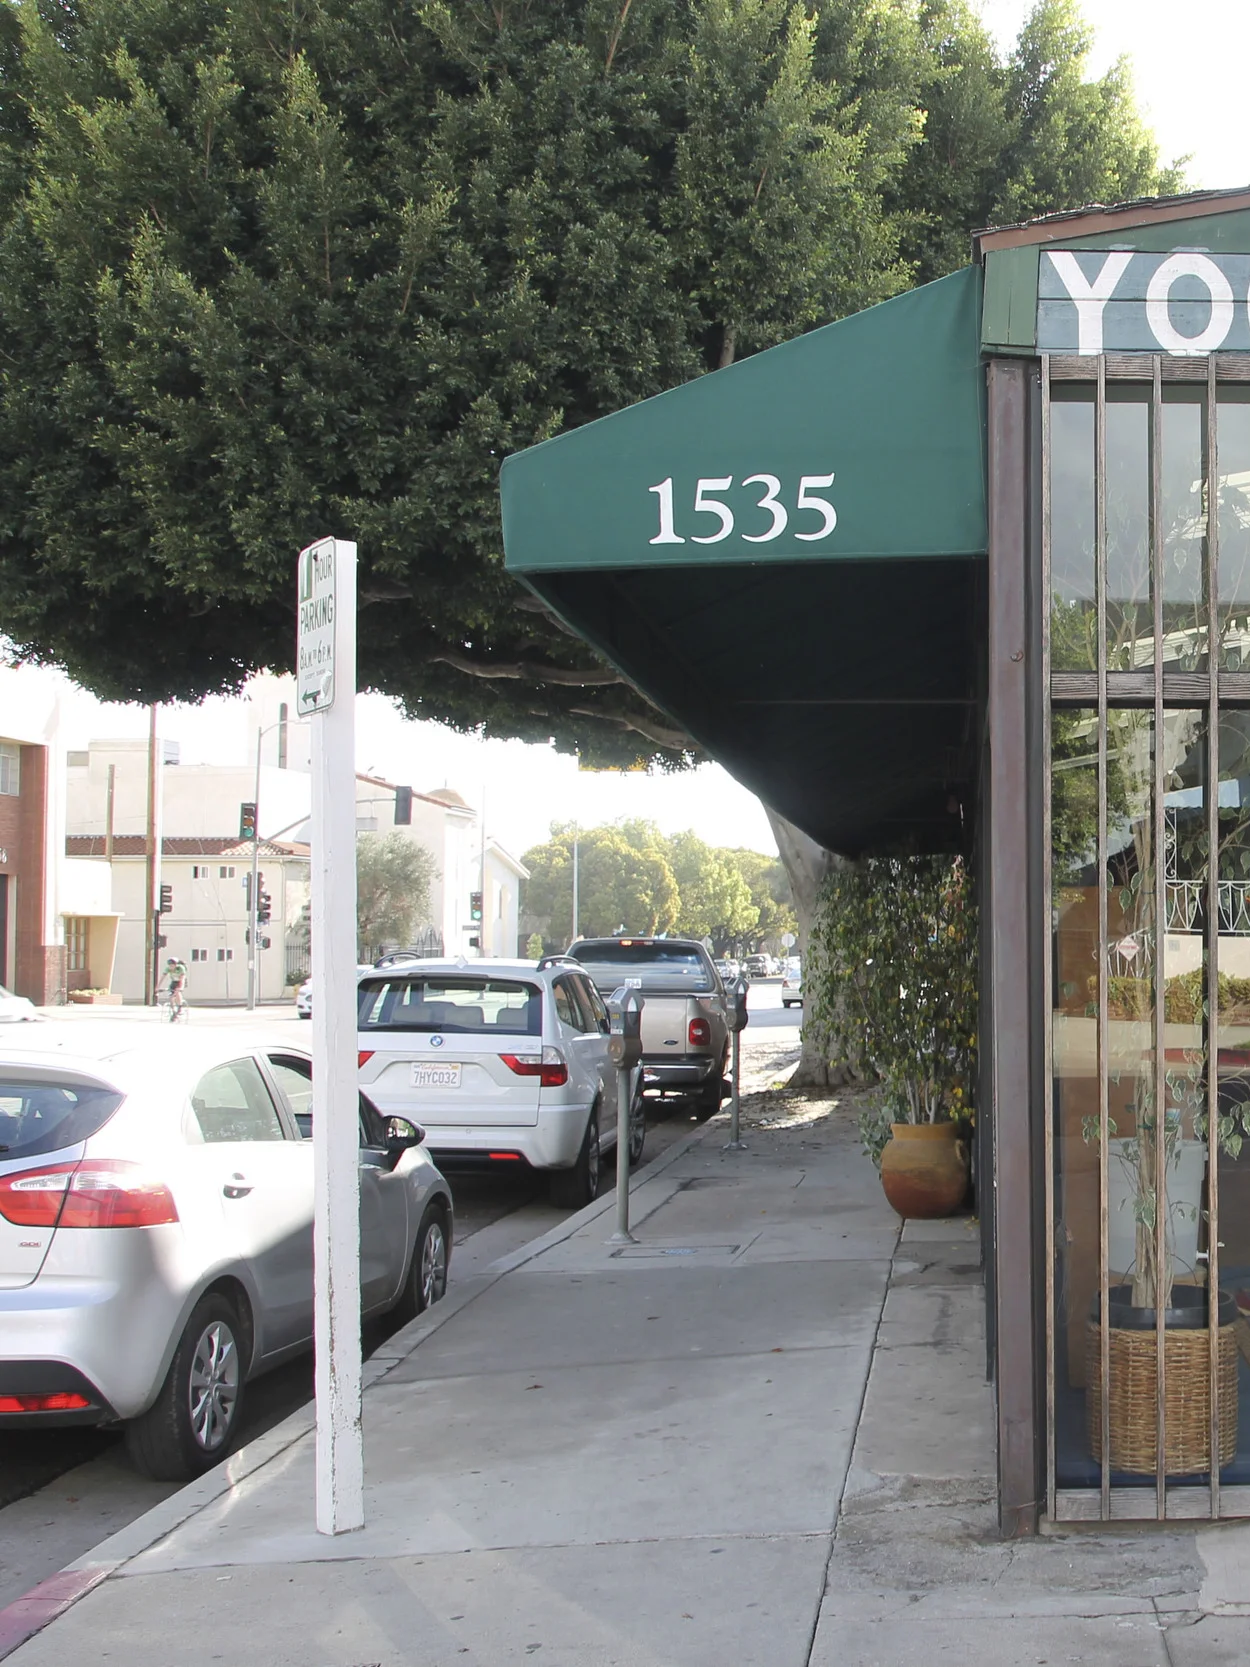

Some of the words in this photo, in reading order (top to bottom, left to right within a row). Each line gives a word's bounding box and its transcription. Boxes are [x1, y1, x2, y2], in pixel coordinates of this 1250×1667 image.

[649, 473, 838, 544] 1535
[315, 554, 333, 587] HOUR
[300, 593, 333, 636] PARKING
[414, 1071, 457, 1084] 7HYC032
